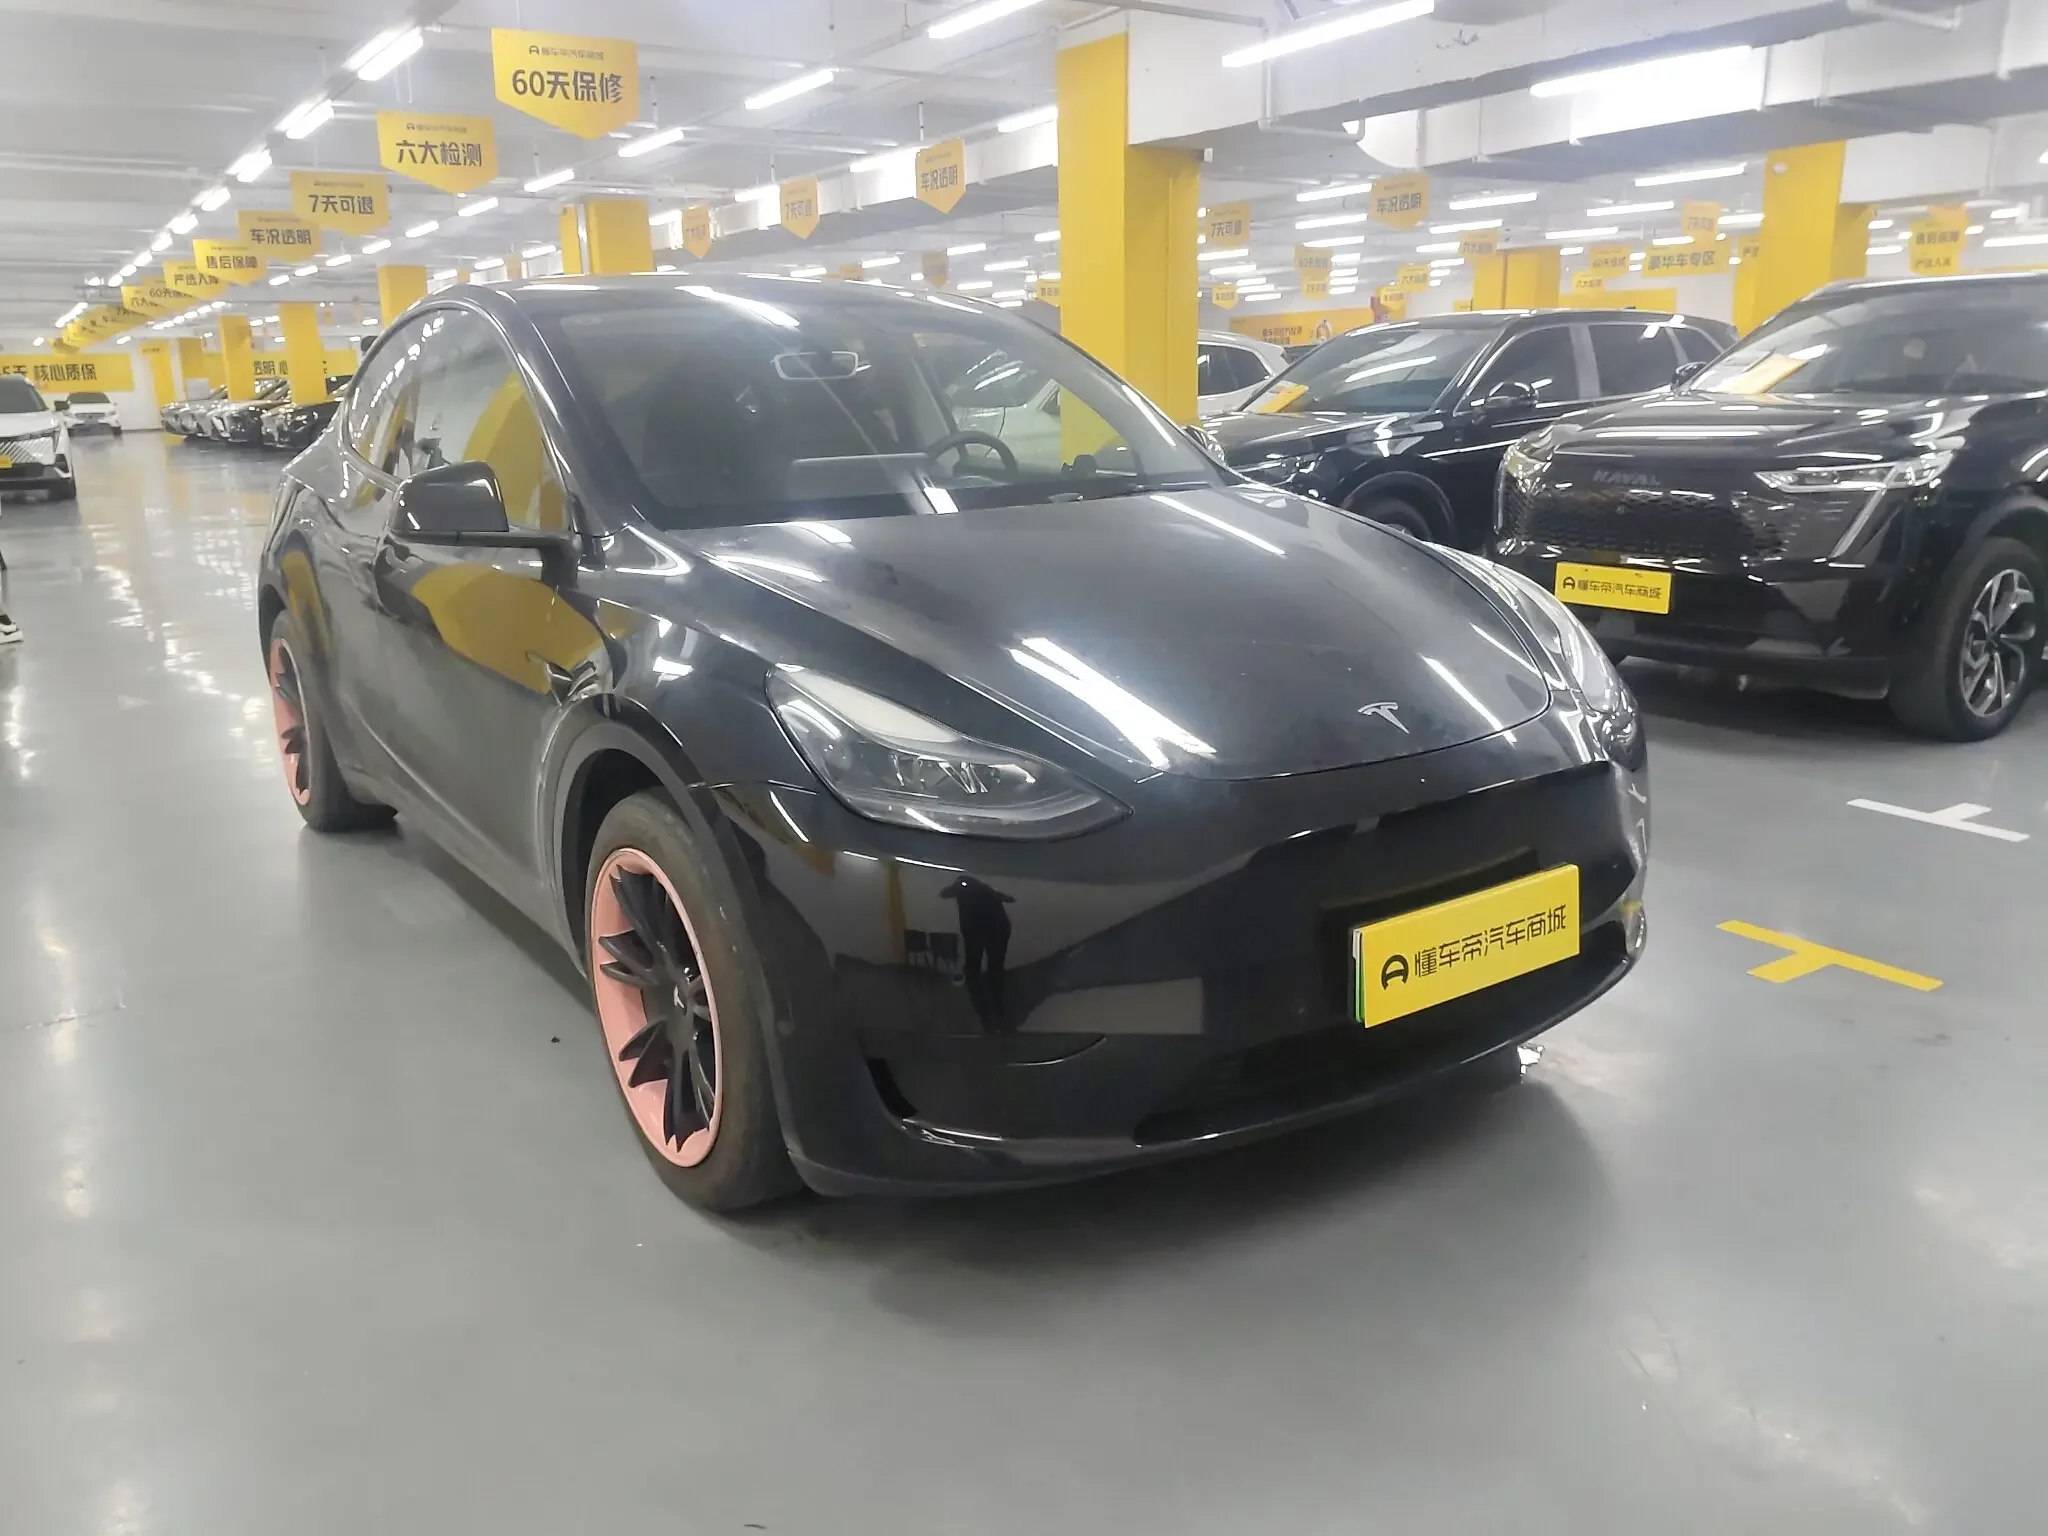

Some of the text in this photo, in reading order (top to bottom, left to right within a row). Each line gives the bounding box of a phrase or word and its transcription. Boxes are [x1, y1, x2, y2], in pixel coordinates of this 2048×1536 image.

[512, 69, 624, 103] 60天保修
[396, 140, 482, 167] 六大检测
[308, 194, 375, 215] 7天可退
[250, 228, 312, 245] 车况透明
[1414, 903, 1567, 979] 懂车帝汽车商城
